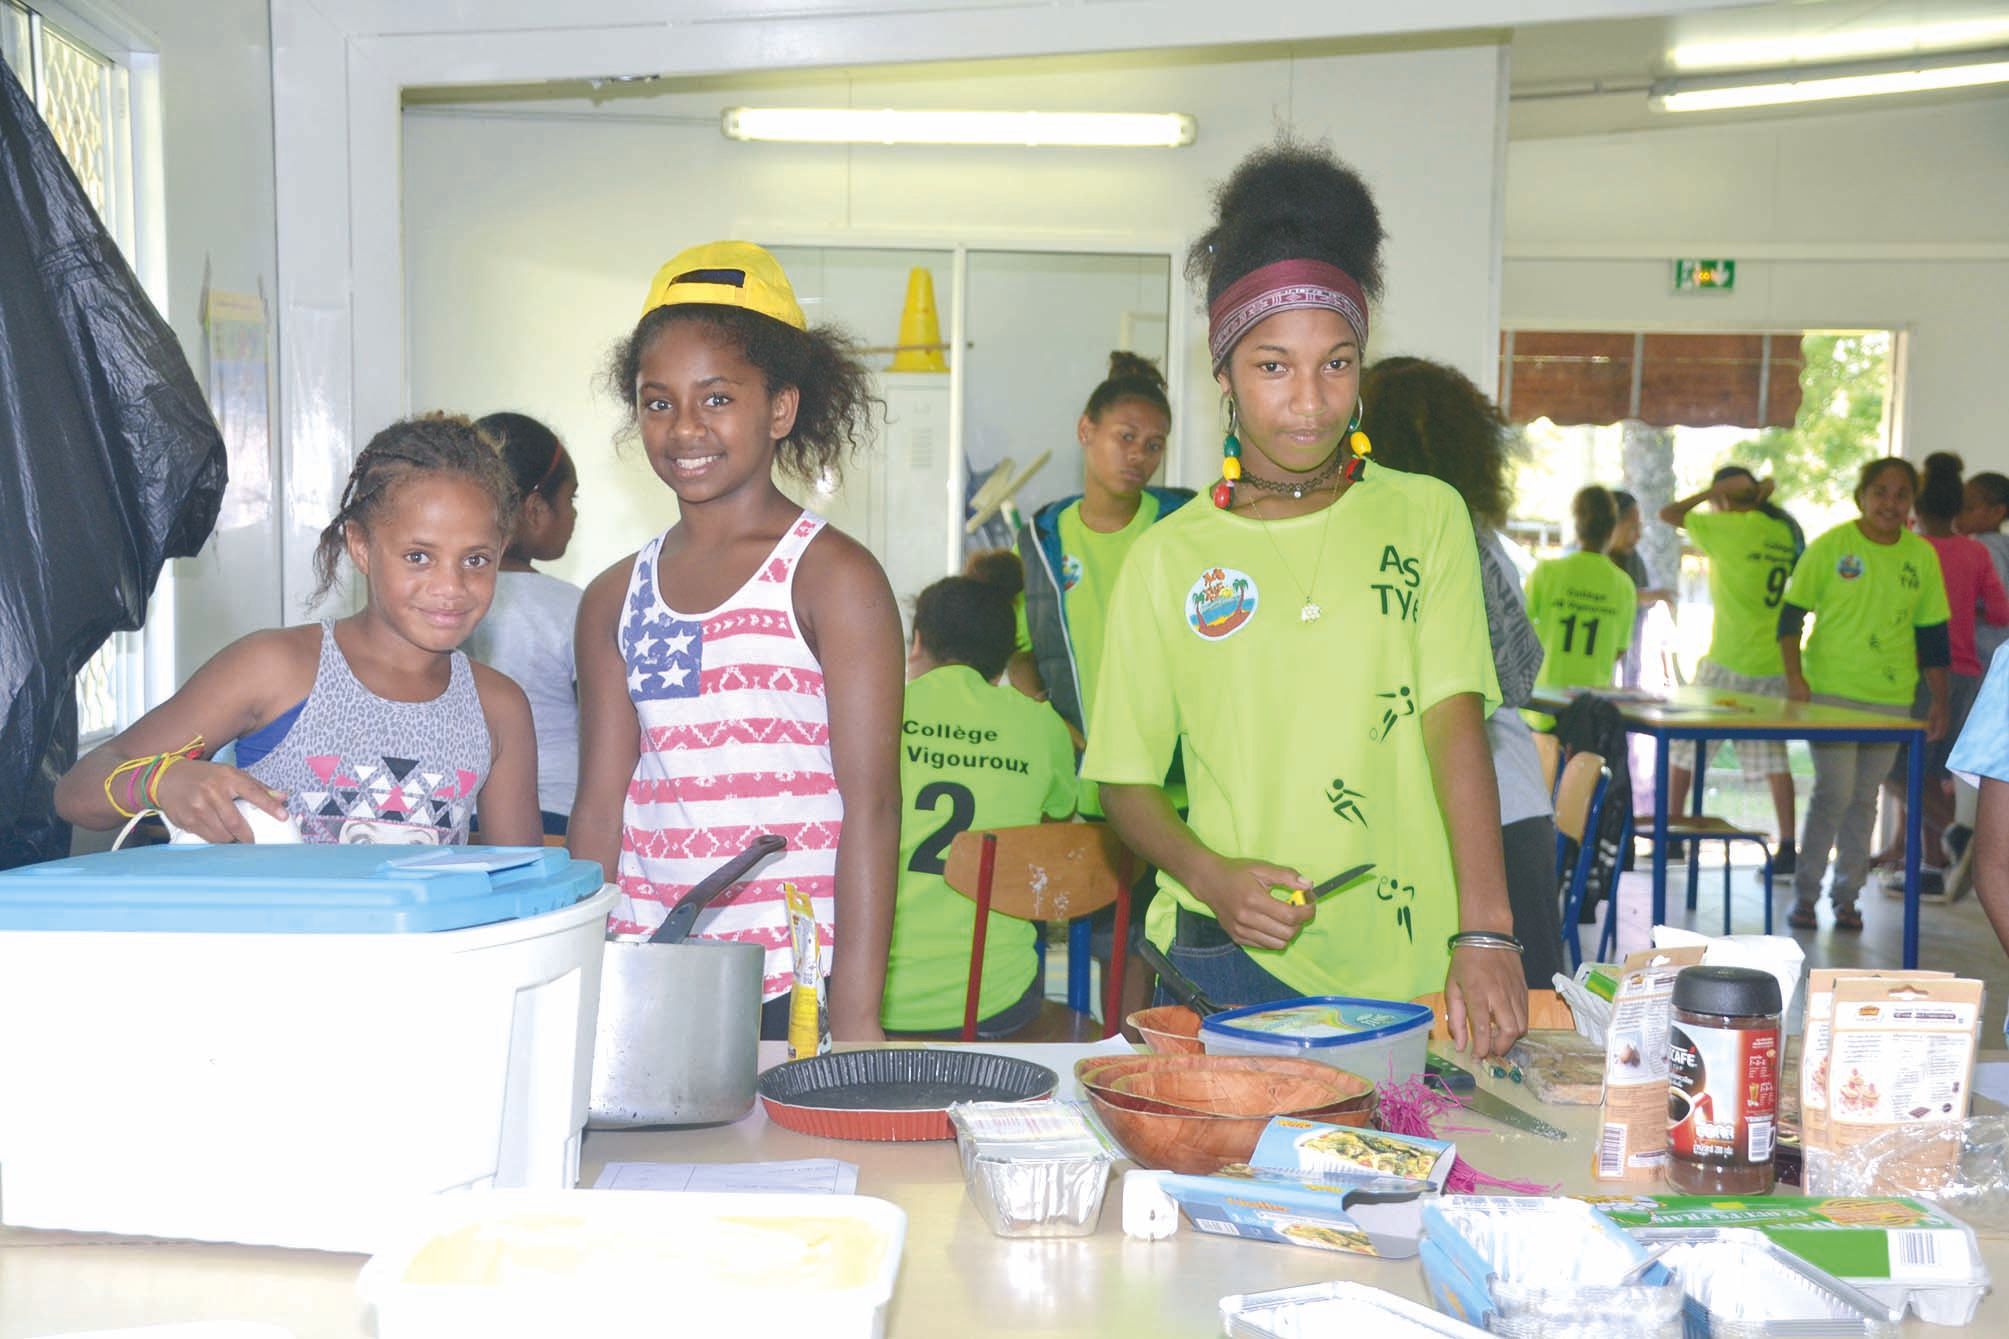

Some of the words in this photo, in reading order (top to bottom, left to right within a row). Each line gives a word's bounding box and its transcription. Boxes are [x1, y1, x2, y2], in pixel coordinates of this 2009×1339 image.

[1379, 545, 1420, 588] AS
[1764, 567, 1787, 608] 9
[1559, 614, 1600, 656] 11
[902, 720, 999, 745] Collège
[907, 745, 1030, 775] Vigouroux
[907, 781, 976, 876] 2
